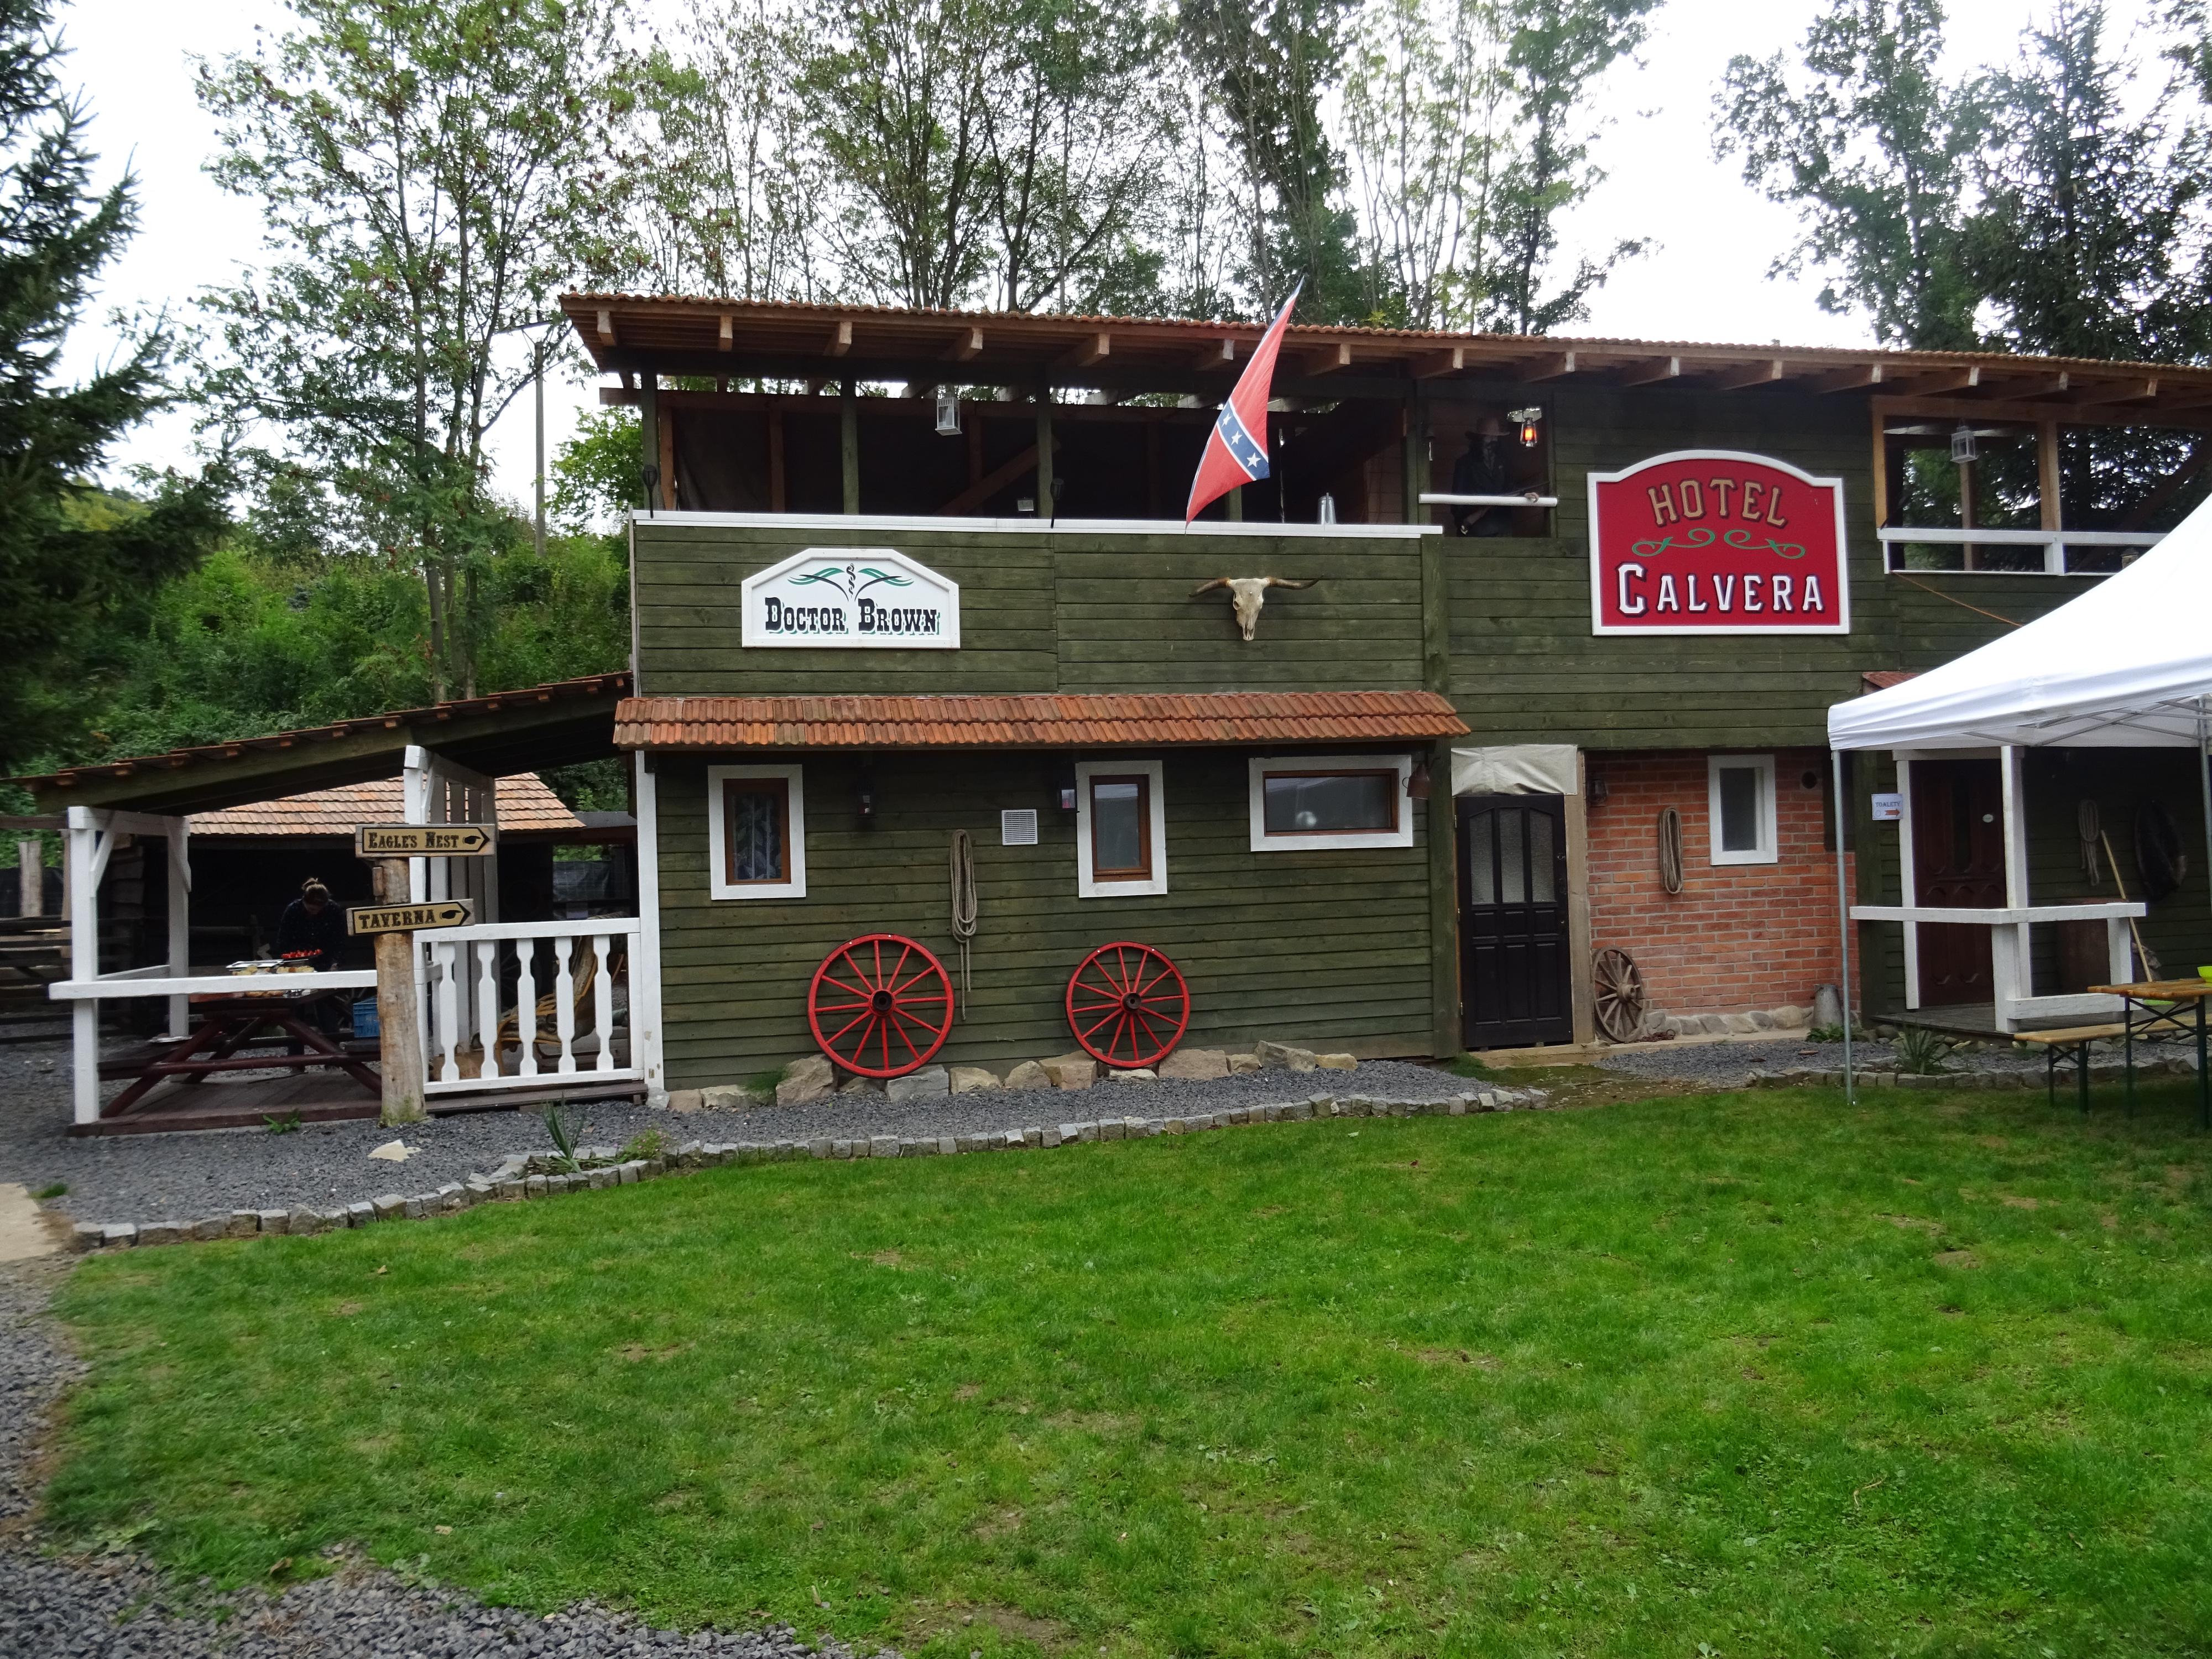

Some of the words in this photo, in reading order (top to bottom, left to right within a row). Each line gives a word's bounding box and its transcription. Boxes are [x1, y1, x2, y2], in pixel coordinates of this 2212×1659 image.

[1647, 478, 1788, 527] HOTEL
[1616, 561, 1825, 618] CALVERA
[765, 597, 848, 634] DOCTOR
[858, 598, 940, 635] BROWN
[368, 831, 418, 849] EAGLE'S
[425, 831, 460, 848] NEST
[358, 909, 436, 930] TAVERNA
